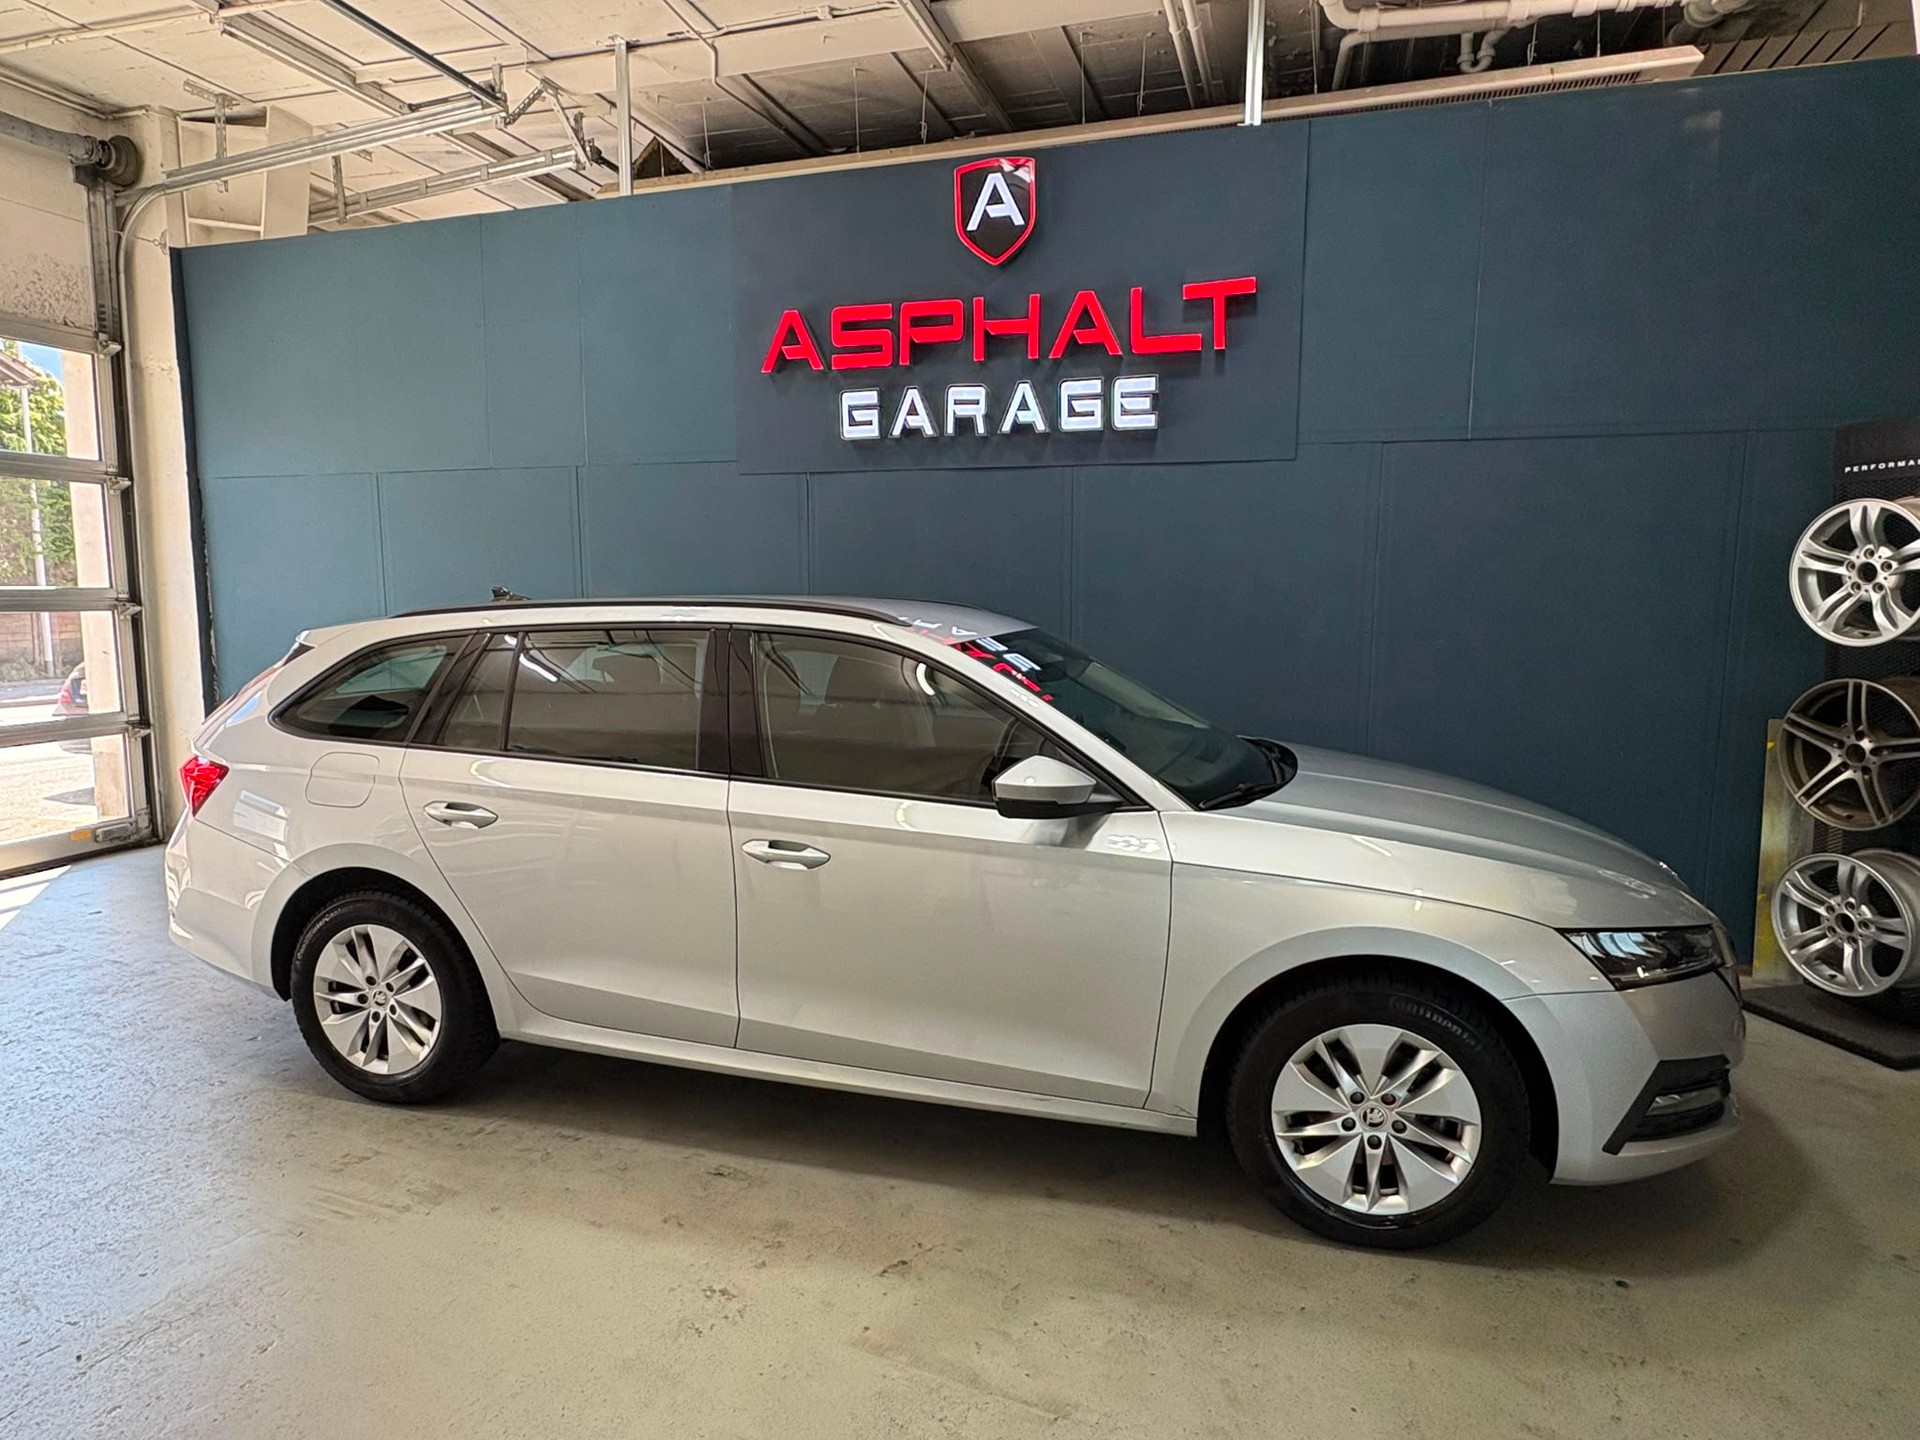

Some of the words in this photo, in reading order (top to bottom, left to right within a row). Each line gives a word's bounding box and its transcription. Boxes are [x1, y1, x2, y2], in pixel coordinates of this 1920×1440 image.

[966, 172, 1025, 231] A
[761, 276, 1257, 374] ASPHALT
[839, 374, 1158, 440] GARAGE
